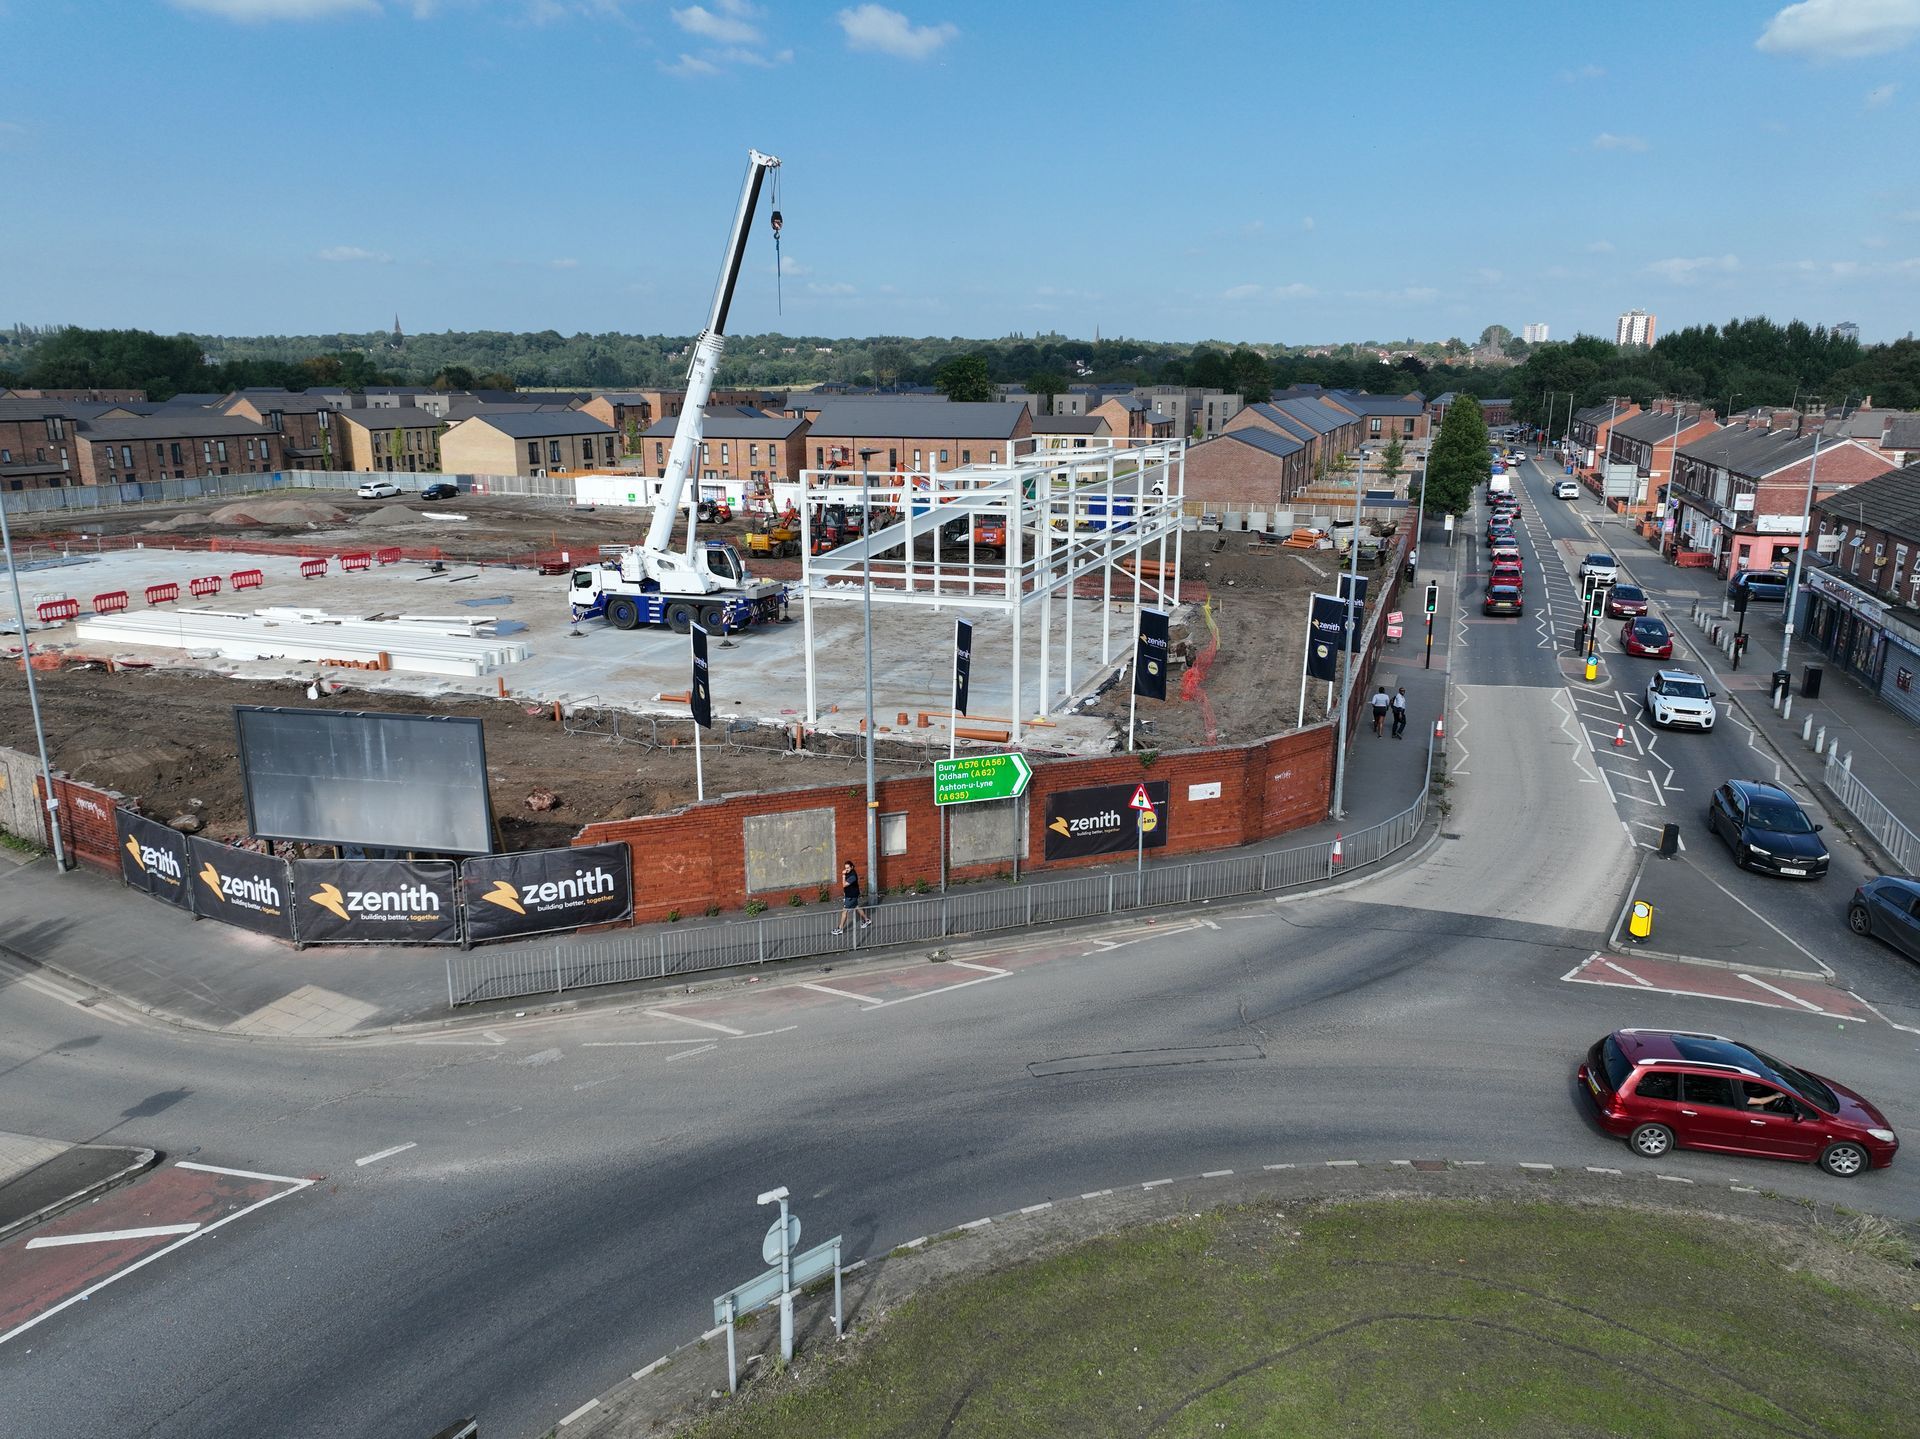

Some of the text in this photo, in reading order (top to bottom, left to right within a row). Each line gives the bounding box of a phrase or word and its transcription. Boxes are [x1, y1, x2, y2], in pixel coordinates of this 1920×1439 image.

[1345, 598, 1364, 607] znith
[1319, 621, 1340, 632] zenith
[1147, 636, 1167, 648] zenith
[938, 763, 956, 772] Bury
[938, 771, 969, 781] Oldham
[938, 780, 994, 792] Ashton-u-Lyne
[1070, 810, 1121, 831] zenith
[140, 845, 181, 878] zenith
[220, 874, 281, 907] zenith
[522, 866, 615, 905] zenith
[347, 883, 440, 912] zenith
[537, 894, 615, 912] building better, together
[360, 913, 440, 922] building better, together
